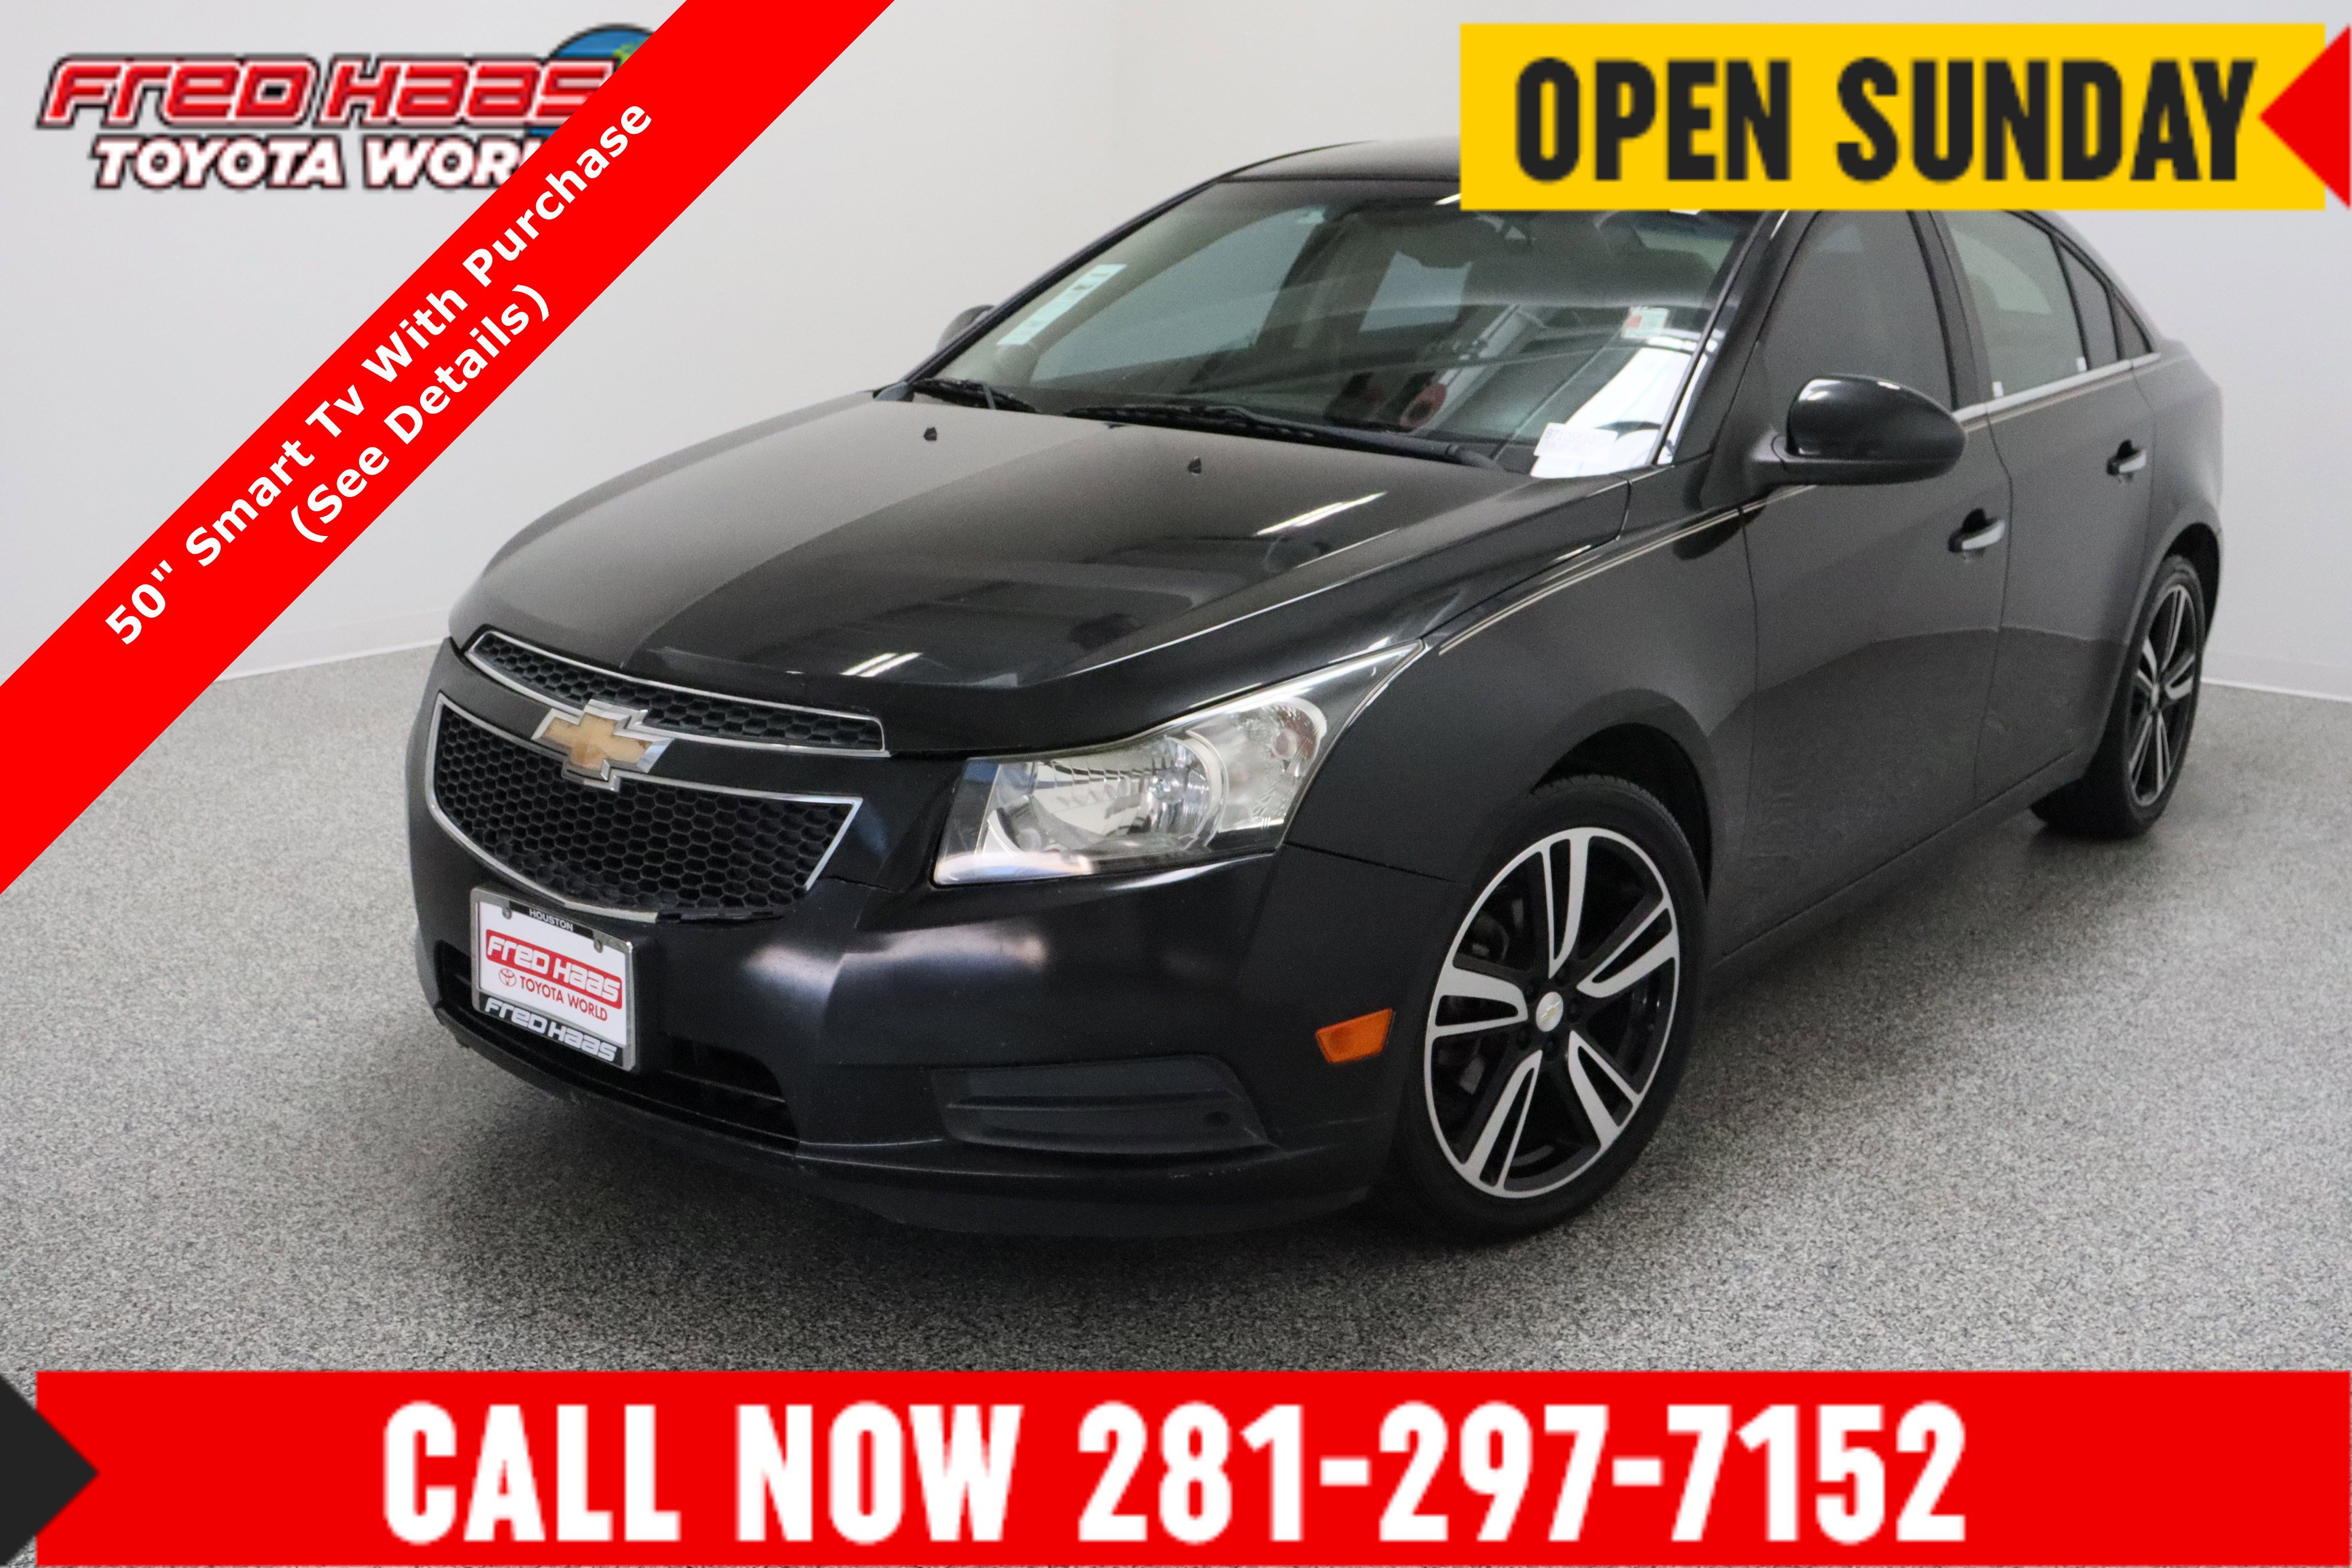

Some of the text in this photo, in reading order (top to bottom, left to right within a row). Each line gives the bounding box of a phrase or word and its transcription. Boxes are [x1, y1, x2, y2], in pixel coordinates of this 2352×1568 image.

[529, 909, 574, 932] HOUSTON
[520, 976, 608, 1022] TOYOTA WORLD
